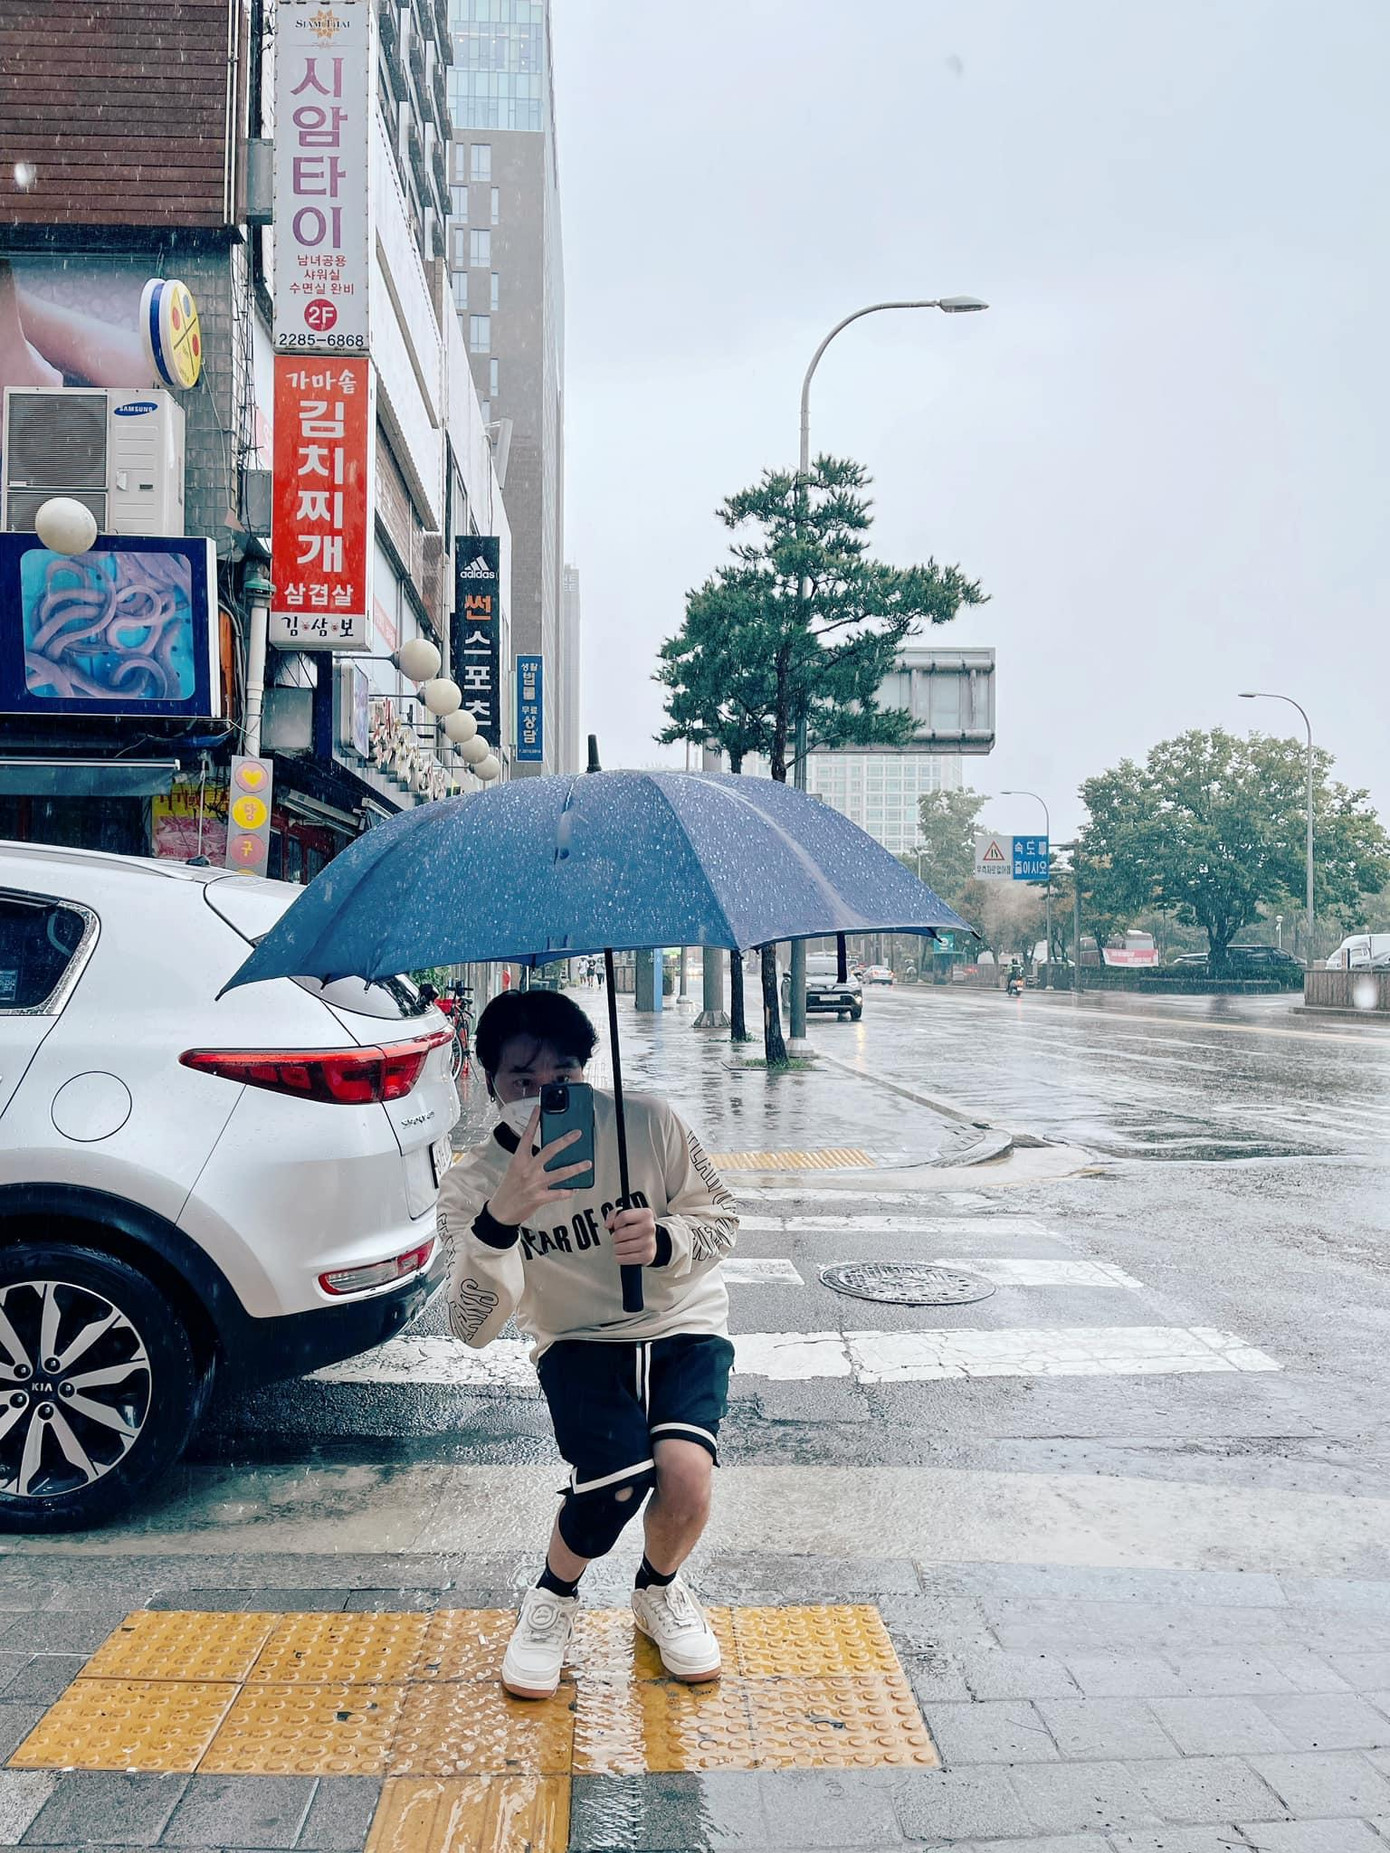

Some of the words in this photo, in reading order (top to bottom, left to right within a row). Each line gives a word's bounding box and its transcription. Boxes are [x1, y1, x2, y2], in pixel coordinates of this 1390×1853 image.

[290, 57, 349, 249] 시암타이
[296, 254, 347, 268] 남녀공용
[289, 282, 327, 296] 수면실
[330, 282, 355, 296] 완비
[307, 307, 335, 325] 2F
[278, 333, 365, 348] 2285-6868
[285, 369, 358, 395] 가마솥
[119, 405, 153, 413] SAMSUNG
[296, 400, 346, 573] 김치찌개
[460, 570, 495, 580] adidas
[284, 583, 354, 607] 삼겹살
[1014, 860, 1047, 875] 줄이시오
[571, 1208, 601, 1251] OF
[31, 1382, 53, 1392] KIA
